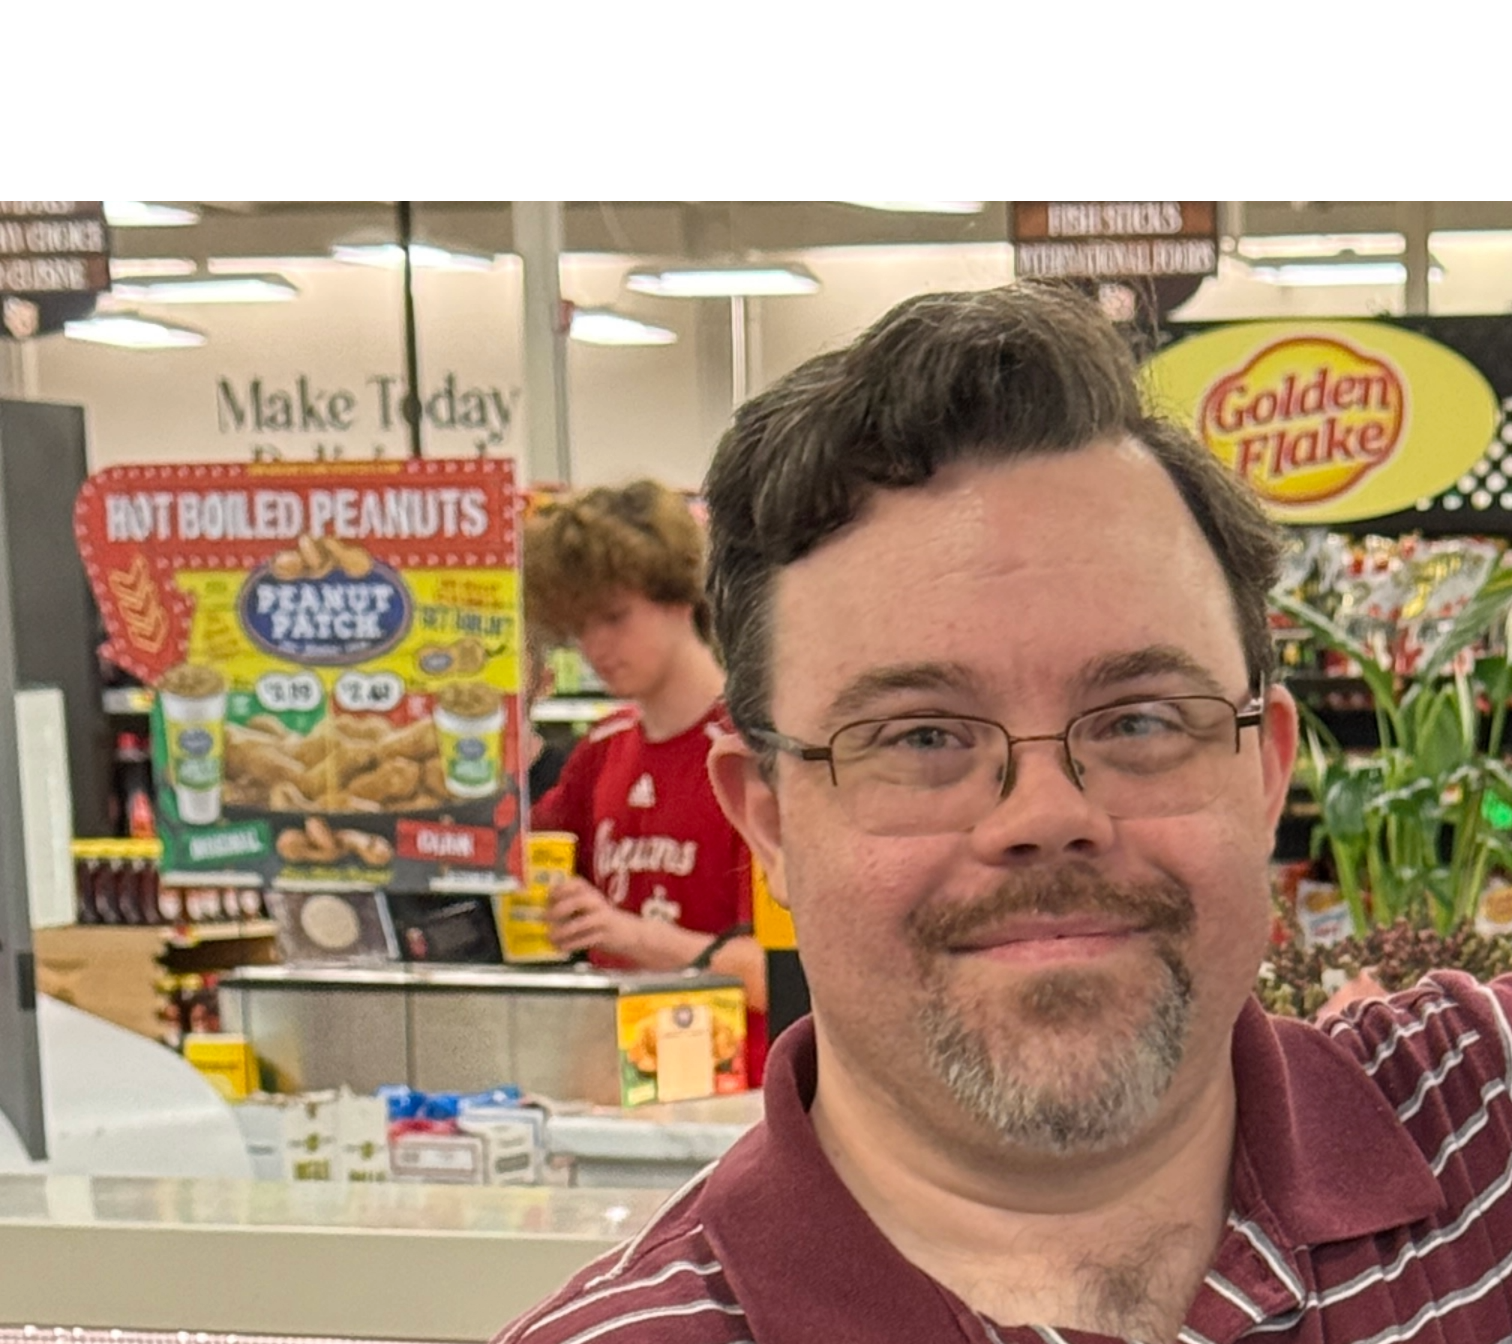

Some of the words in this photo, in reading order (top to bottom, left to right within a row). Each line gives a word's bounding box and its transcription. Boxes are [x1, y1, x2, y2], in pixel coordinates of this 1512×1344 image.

[216, 375, 355, 432] Make
[367, 372, 520, 445] Tday
[1214, 366, 1389, 432] Golden
[1238, 416, 1385, 478] Flake
[106, 492, 174, 541] HOT
[178, 489, 300, 540] BOILED
[310, 486, 489, 537] PEANUTS
[256, 583, 394, 614] PEANUT
[271, 612, 382, 640] PATCH
